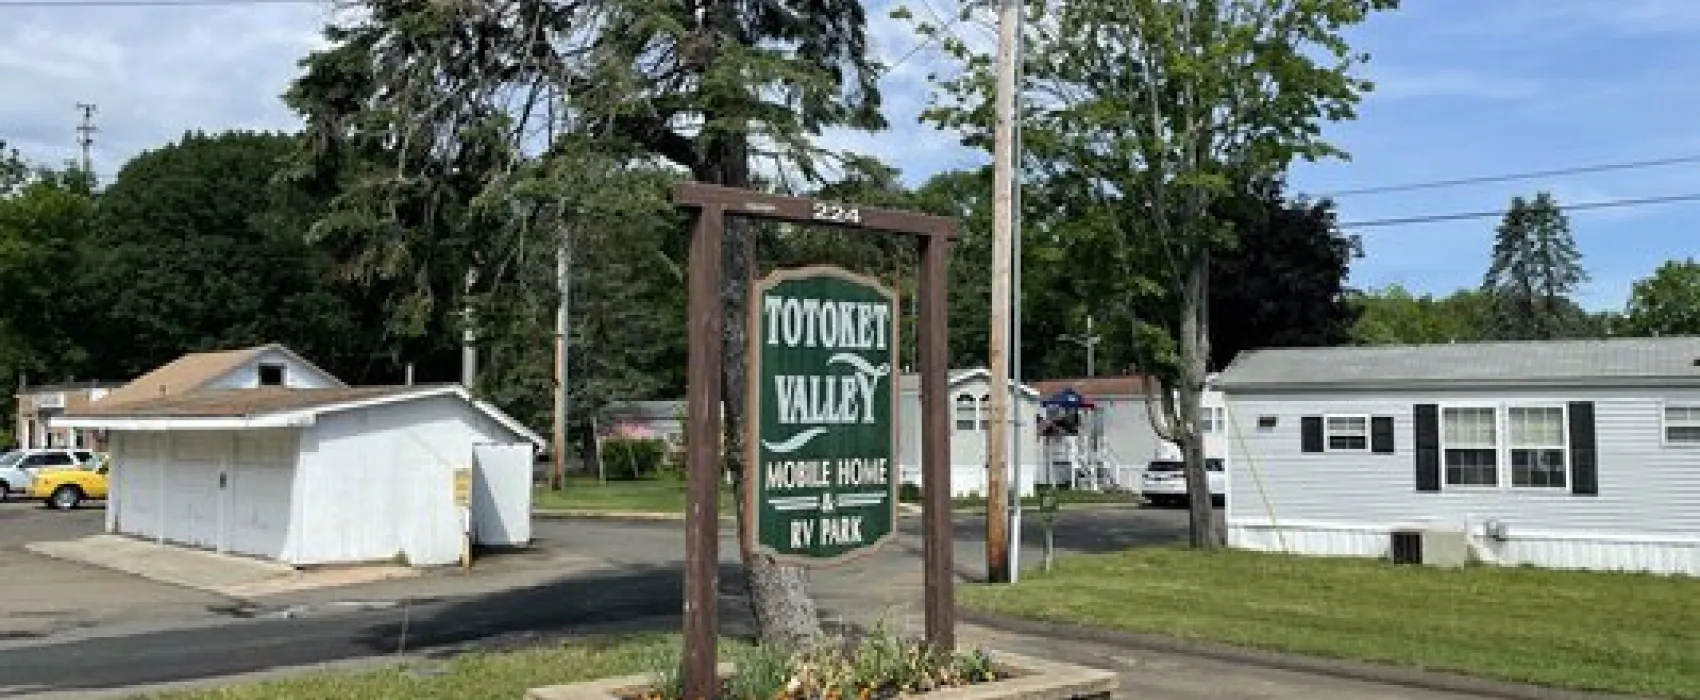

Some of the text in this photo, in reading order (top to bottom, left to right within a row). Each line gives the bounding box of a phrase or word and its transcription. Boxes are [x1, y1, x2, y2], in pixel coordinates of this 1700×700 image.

[813, 203, 860, 223] 224
[764, 296, 888, 350] TOTOKET
[774, 375, 878, 424] VALLEY
[765, 458, 888, 490] MOBILE HOME
[821, 493, 835, 513] &
[790, 516, 863, 548] RV PARK
